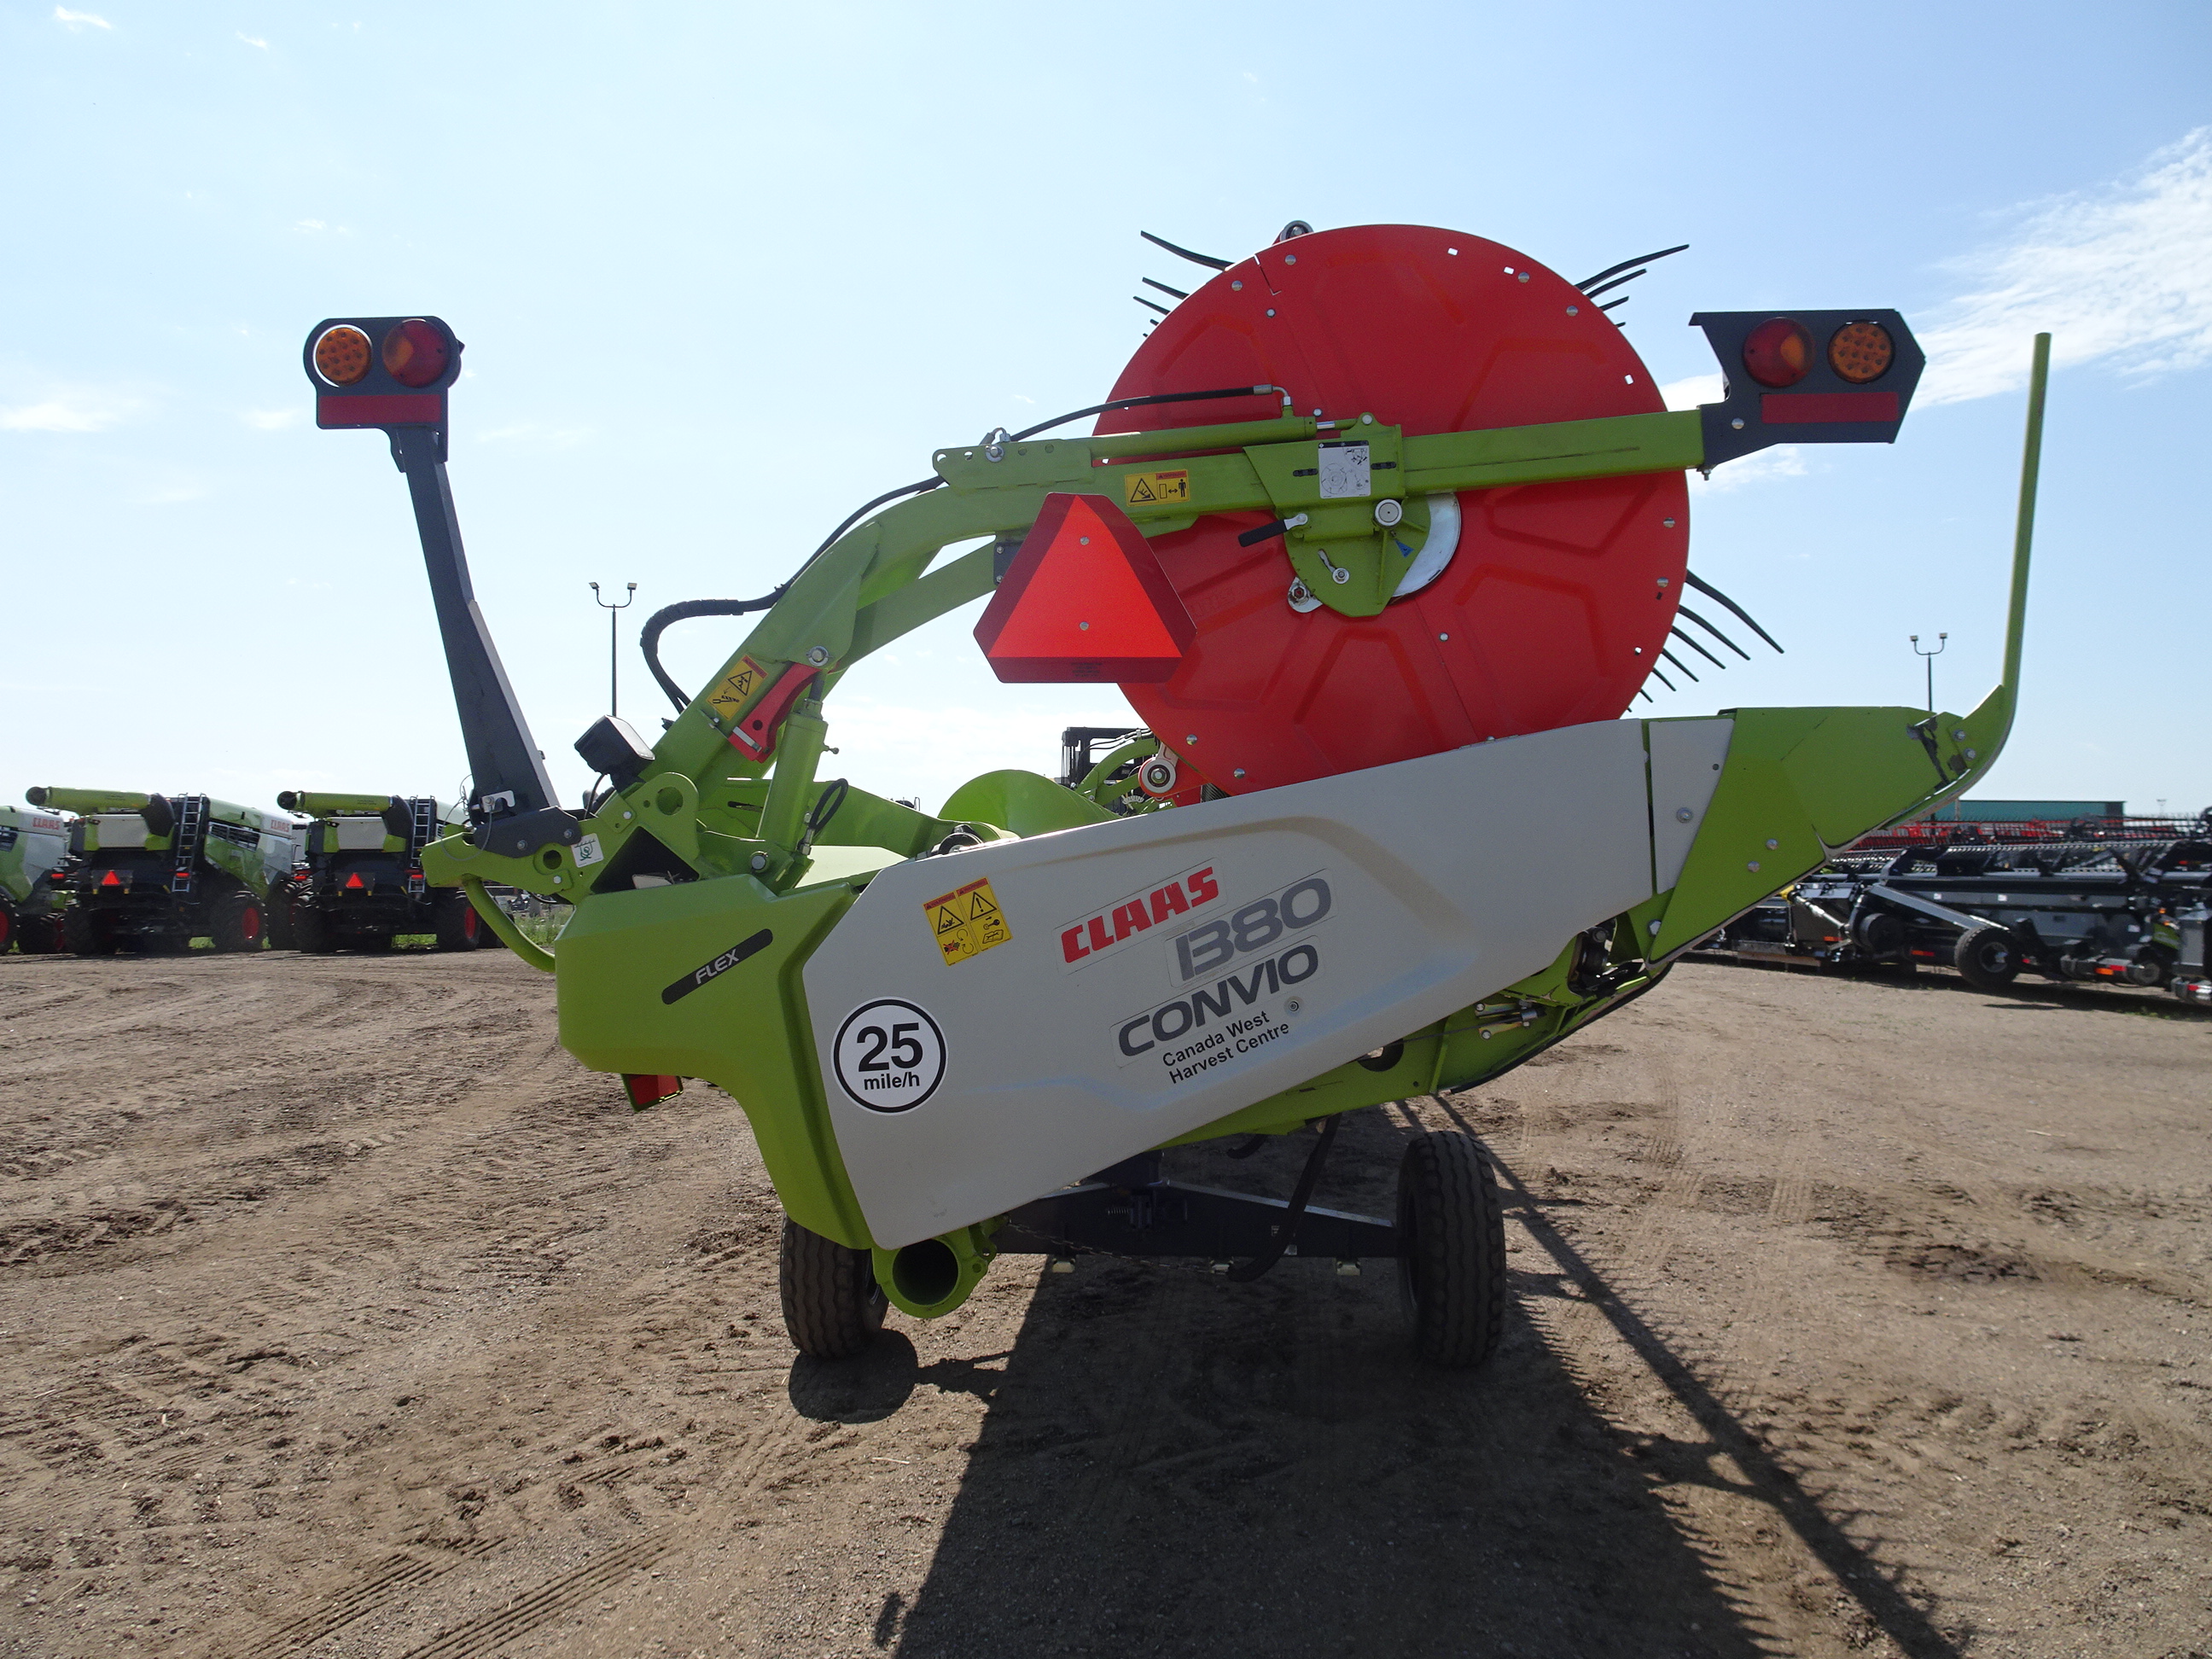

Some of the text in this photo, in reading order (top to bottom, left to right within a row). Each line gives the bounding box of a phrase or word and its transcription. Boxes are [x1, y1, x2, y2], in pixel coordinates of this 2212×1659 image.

[1061, 866, 1220, 963] CLAAS
[1175, 878, 1332, 981] 1380
[696, 948, 740, 985] FLEX
[1118, 944, 1319, 1057] CONVIO
[856, 1022, 923, 1073] 25
[1162, 1010, 1270, 1067] Canada West
[1168, 1023, 1289, 1085] Harvest Centre
[864, 1071, 920, 1091] mile/h
